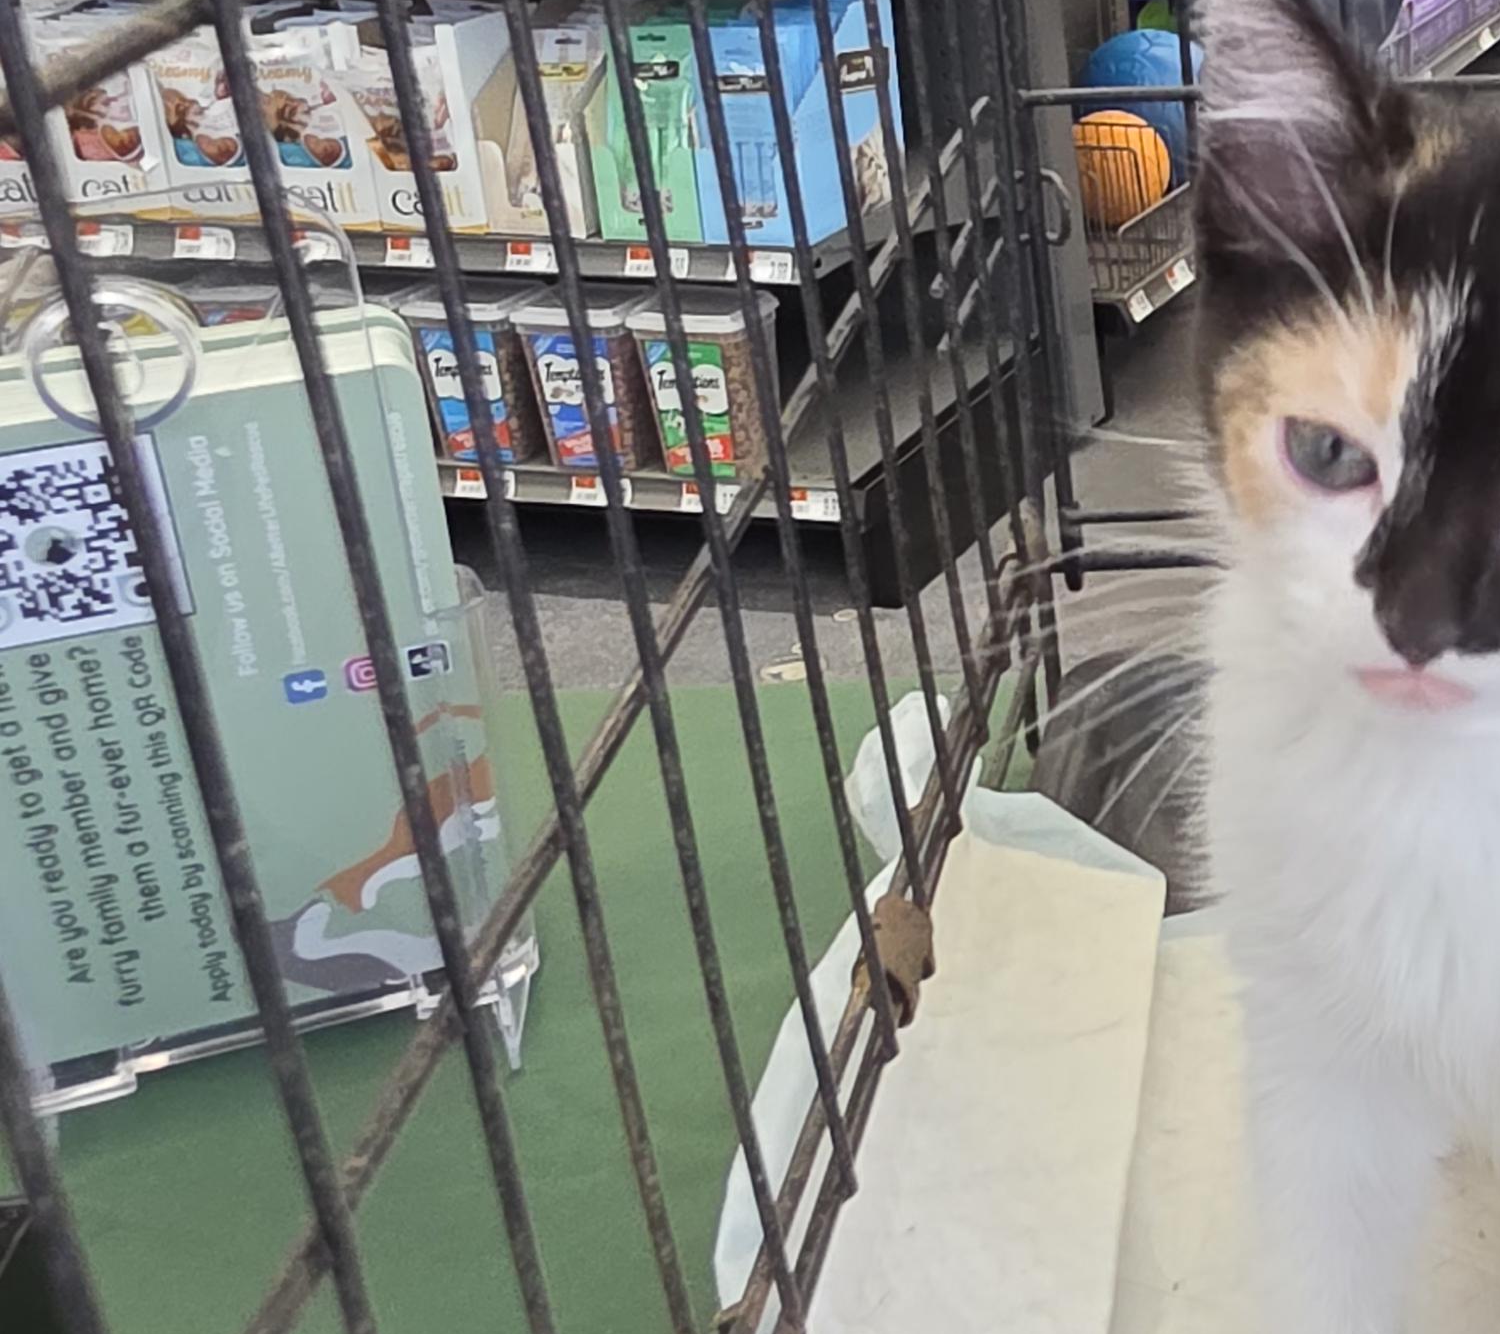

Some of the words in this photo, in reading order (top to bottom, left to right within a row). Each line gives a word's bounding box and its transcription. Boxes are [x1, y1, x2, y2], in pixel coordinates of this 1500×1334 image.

[391, 186, 466, 216] cait
[656, 369, 720, 391] Temtions
[186, 434, 220, 497] Media
[198, 499, 233, 559] Social
[217, 562, 240, 588] on
[224, 589, 247, 614] us
[118, 634, 153, 689] Code
[231, 617, 260, 679] Follow
[28, 652, 69, 706] give
[65, 645, 117, 732] home?
[0, 720, 23, 738] a
[132, 692, 167, 727] QR
[36, 712, 78, 762] and
[144, 730, 173, 769] this
[1, 744, 44, 786] get
[97, 737, 144, 835] fur-ever
[20, 791, 47, 819] to
[60, 769, 107, 869] member
[157, 772, 197, 860] scanning
[25, 824, 69, 894] ready
[126, 840, 150, 858] a
[132, 861, 168, 922] them
[180, 862, 206, 891] by
[50, 898, 89, 943] you
[86, 873, 128, 946] family
[188, 892, 220, 948] today
[66, 946, 95, 984] Are
[112, 949, 146, 1007] furry
[201, 950, 236, 1002] Apply
